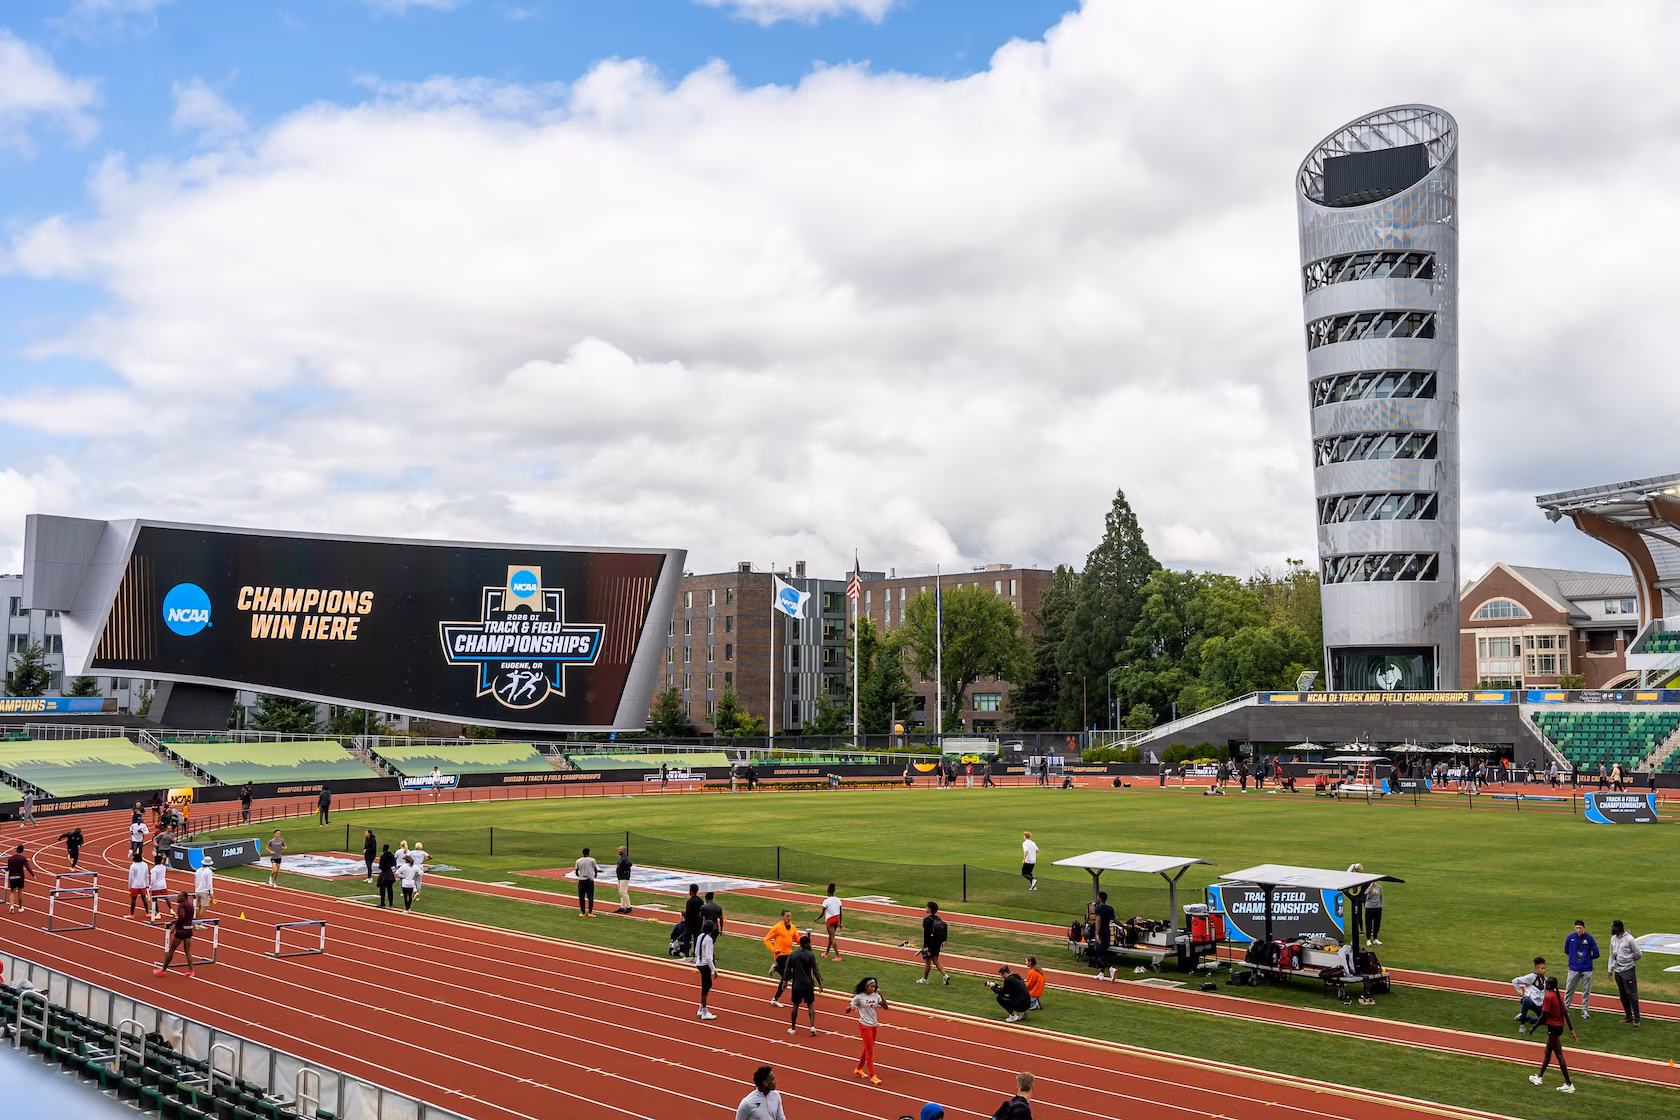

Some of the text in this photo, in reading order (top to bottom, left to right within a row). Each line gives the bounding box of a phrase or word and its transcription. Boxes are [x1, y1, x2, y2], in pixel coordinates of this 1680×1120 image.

[237, 586, 374, 614] CHAMPIONS
[168, 608, 209, 622] NCAA
[251, 614, 360, 640] WIN HERE
[484, 621, 561, 634] TRACK & FIELD
[454, 634, 591, 653] CHAMPIONSHIPS
[1307, 693, 1468, 702] NCAA DI TRACK AND FIELD CHAMPIONSHIPS
[1244, 892, 1306, 902] TRAC & FIELD
